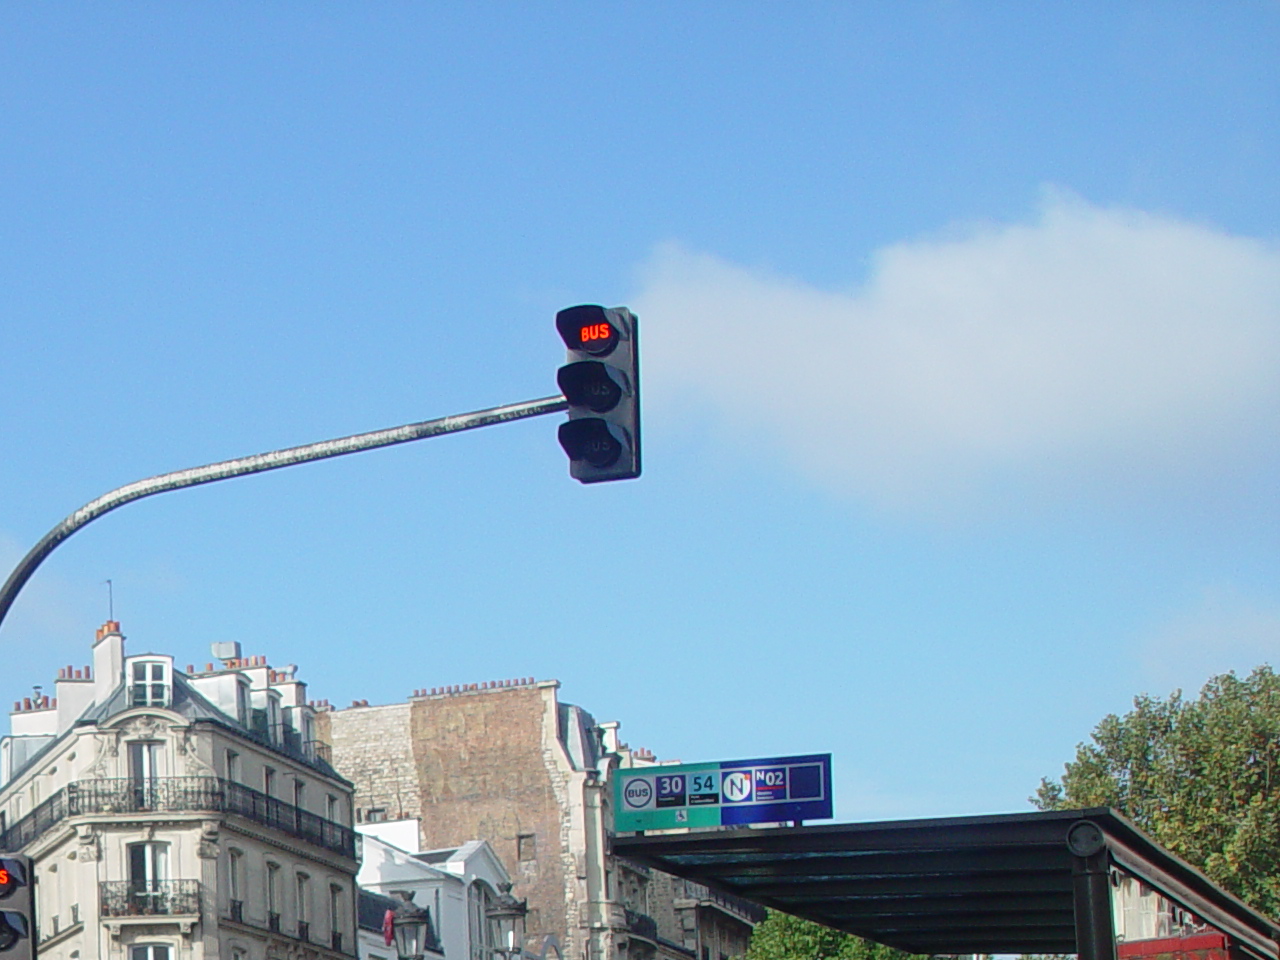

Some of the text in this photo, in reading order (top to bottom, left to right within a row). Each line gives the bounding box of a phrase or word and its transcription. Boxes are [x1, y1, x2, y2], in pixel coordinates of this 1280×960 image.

[581, 323, 609, 342] BUS
[628, 788, 649, 798] BUS
[660, 776, 683, 794] 30
[693, 775, 714, 792] 54
